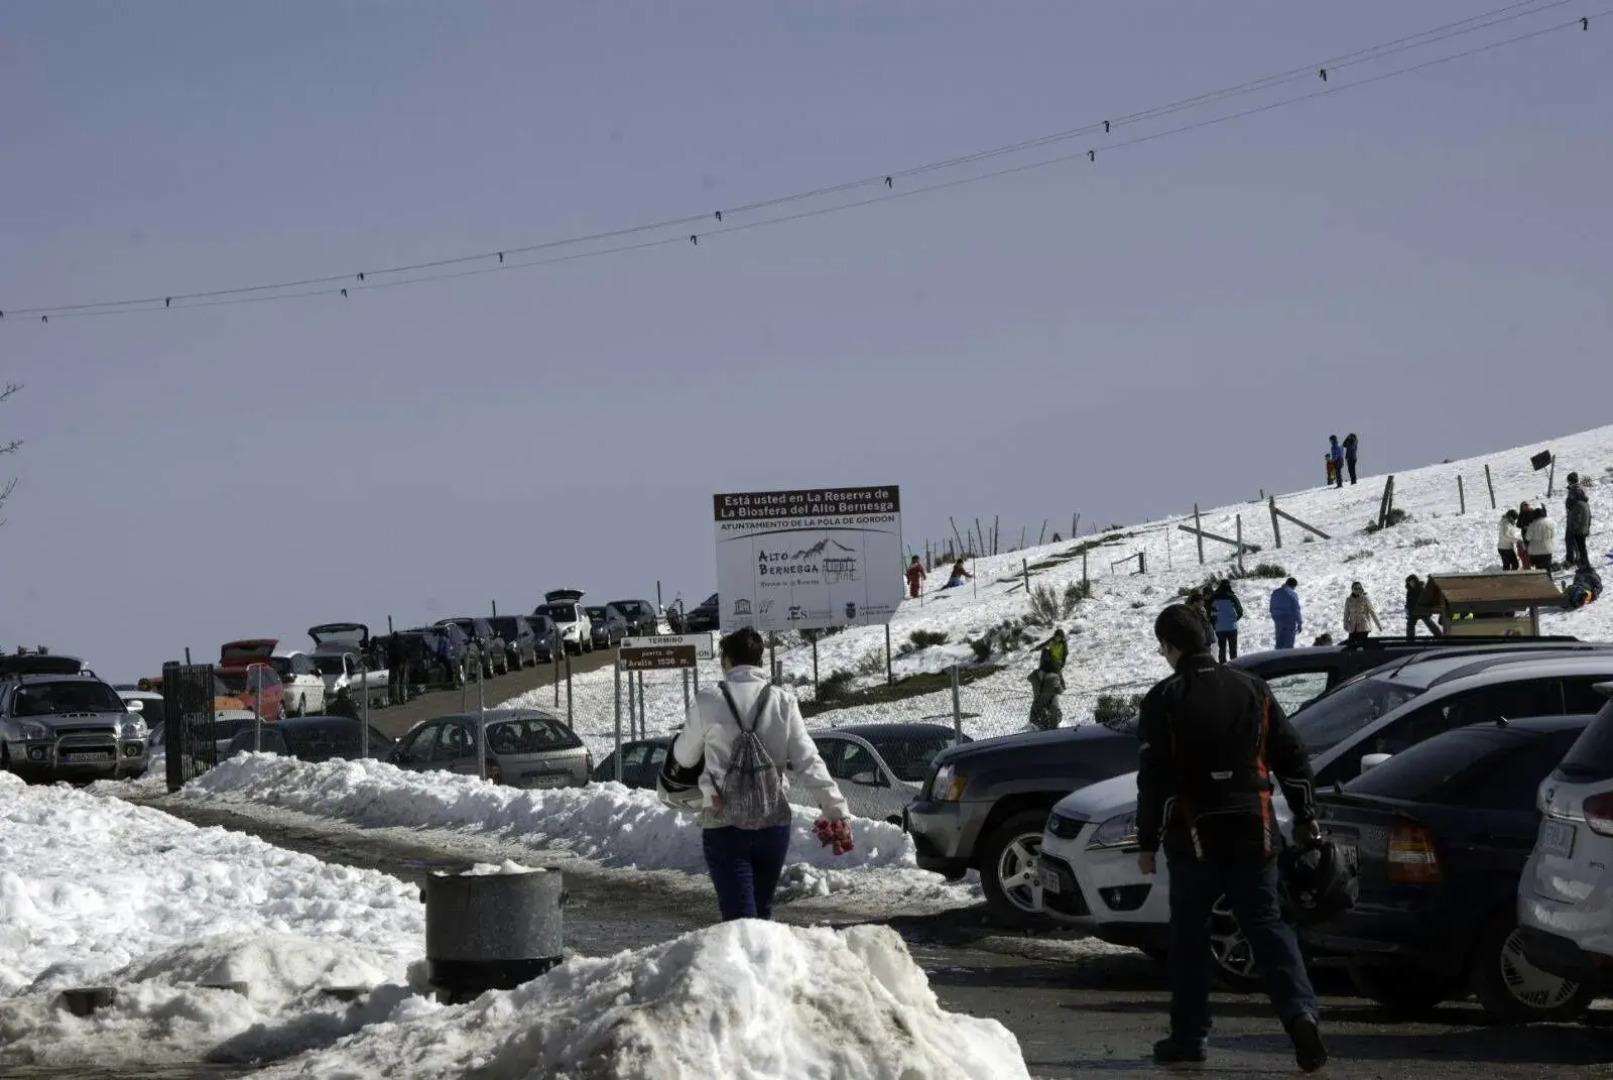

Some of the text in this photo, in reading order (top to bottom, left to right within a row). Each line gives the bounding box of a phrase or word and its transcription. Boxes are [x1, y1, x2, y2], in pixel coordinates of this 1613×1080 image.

[725, 489, 889, 506] Está usted en La Reserva de
[721, 501, 893, 518] La Biosfera del Alto Bernesga
[721, 520, 789, 530] AYUNTAMIENTO
[791, 519, 802, 527] DE
[804, 519, 816, 527] LA
[817, 517, 841, 526] POLA
[843, 516, 854, 524] DE
[758, 550, 789, 562] ALTO
[759, 564, 819, 575] BERNESGA
